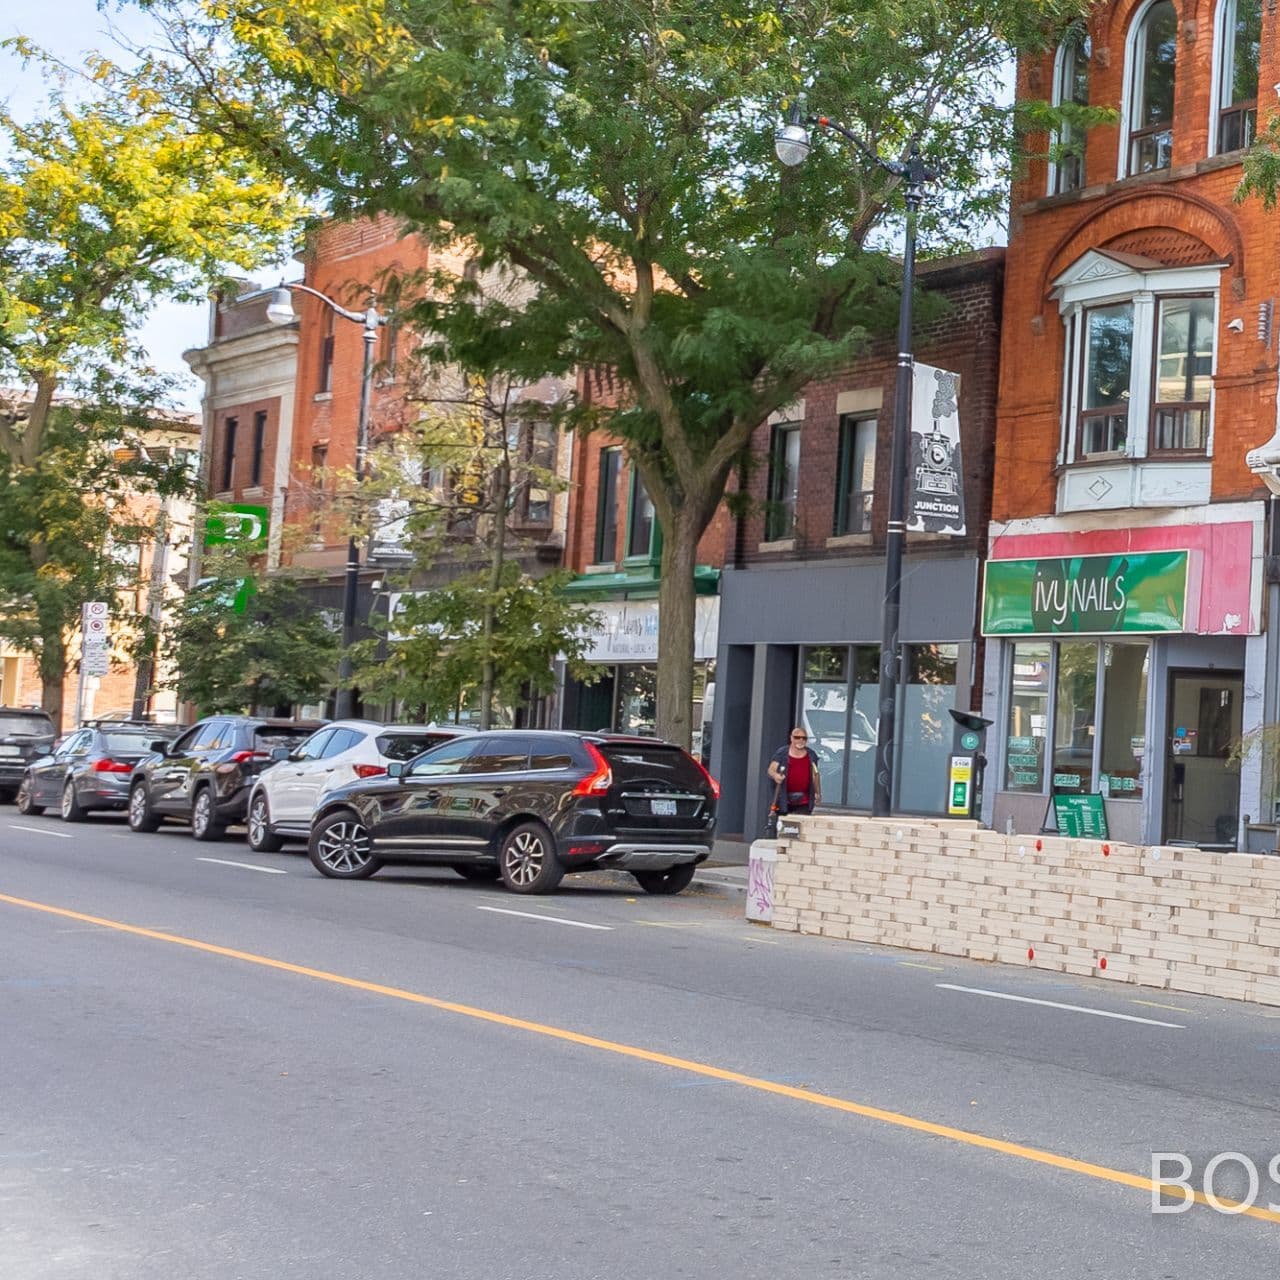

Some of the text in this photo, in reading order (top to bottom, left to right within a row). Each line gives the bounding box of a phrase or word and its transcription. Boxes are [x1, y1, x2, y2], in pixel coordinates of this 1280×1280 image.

[914, 501, 960, 513] JUNCTION
[1035, 571, 1126, 625] ivy NAILS
